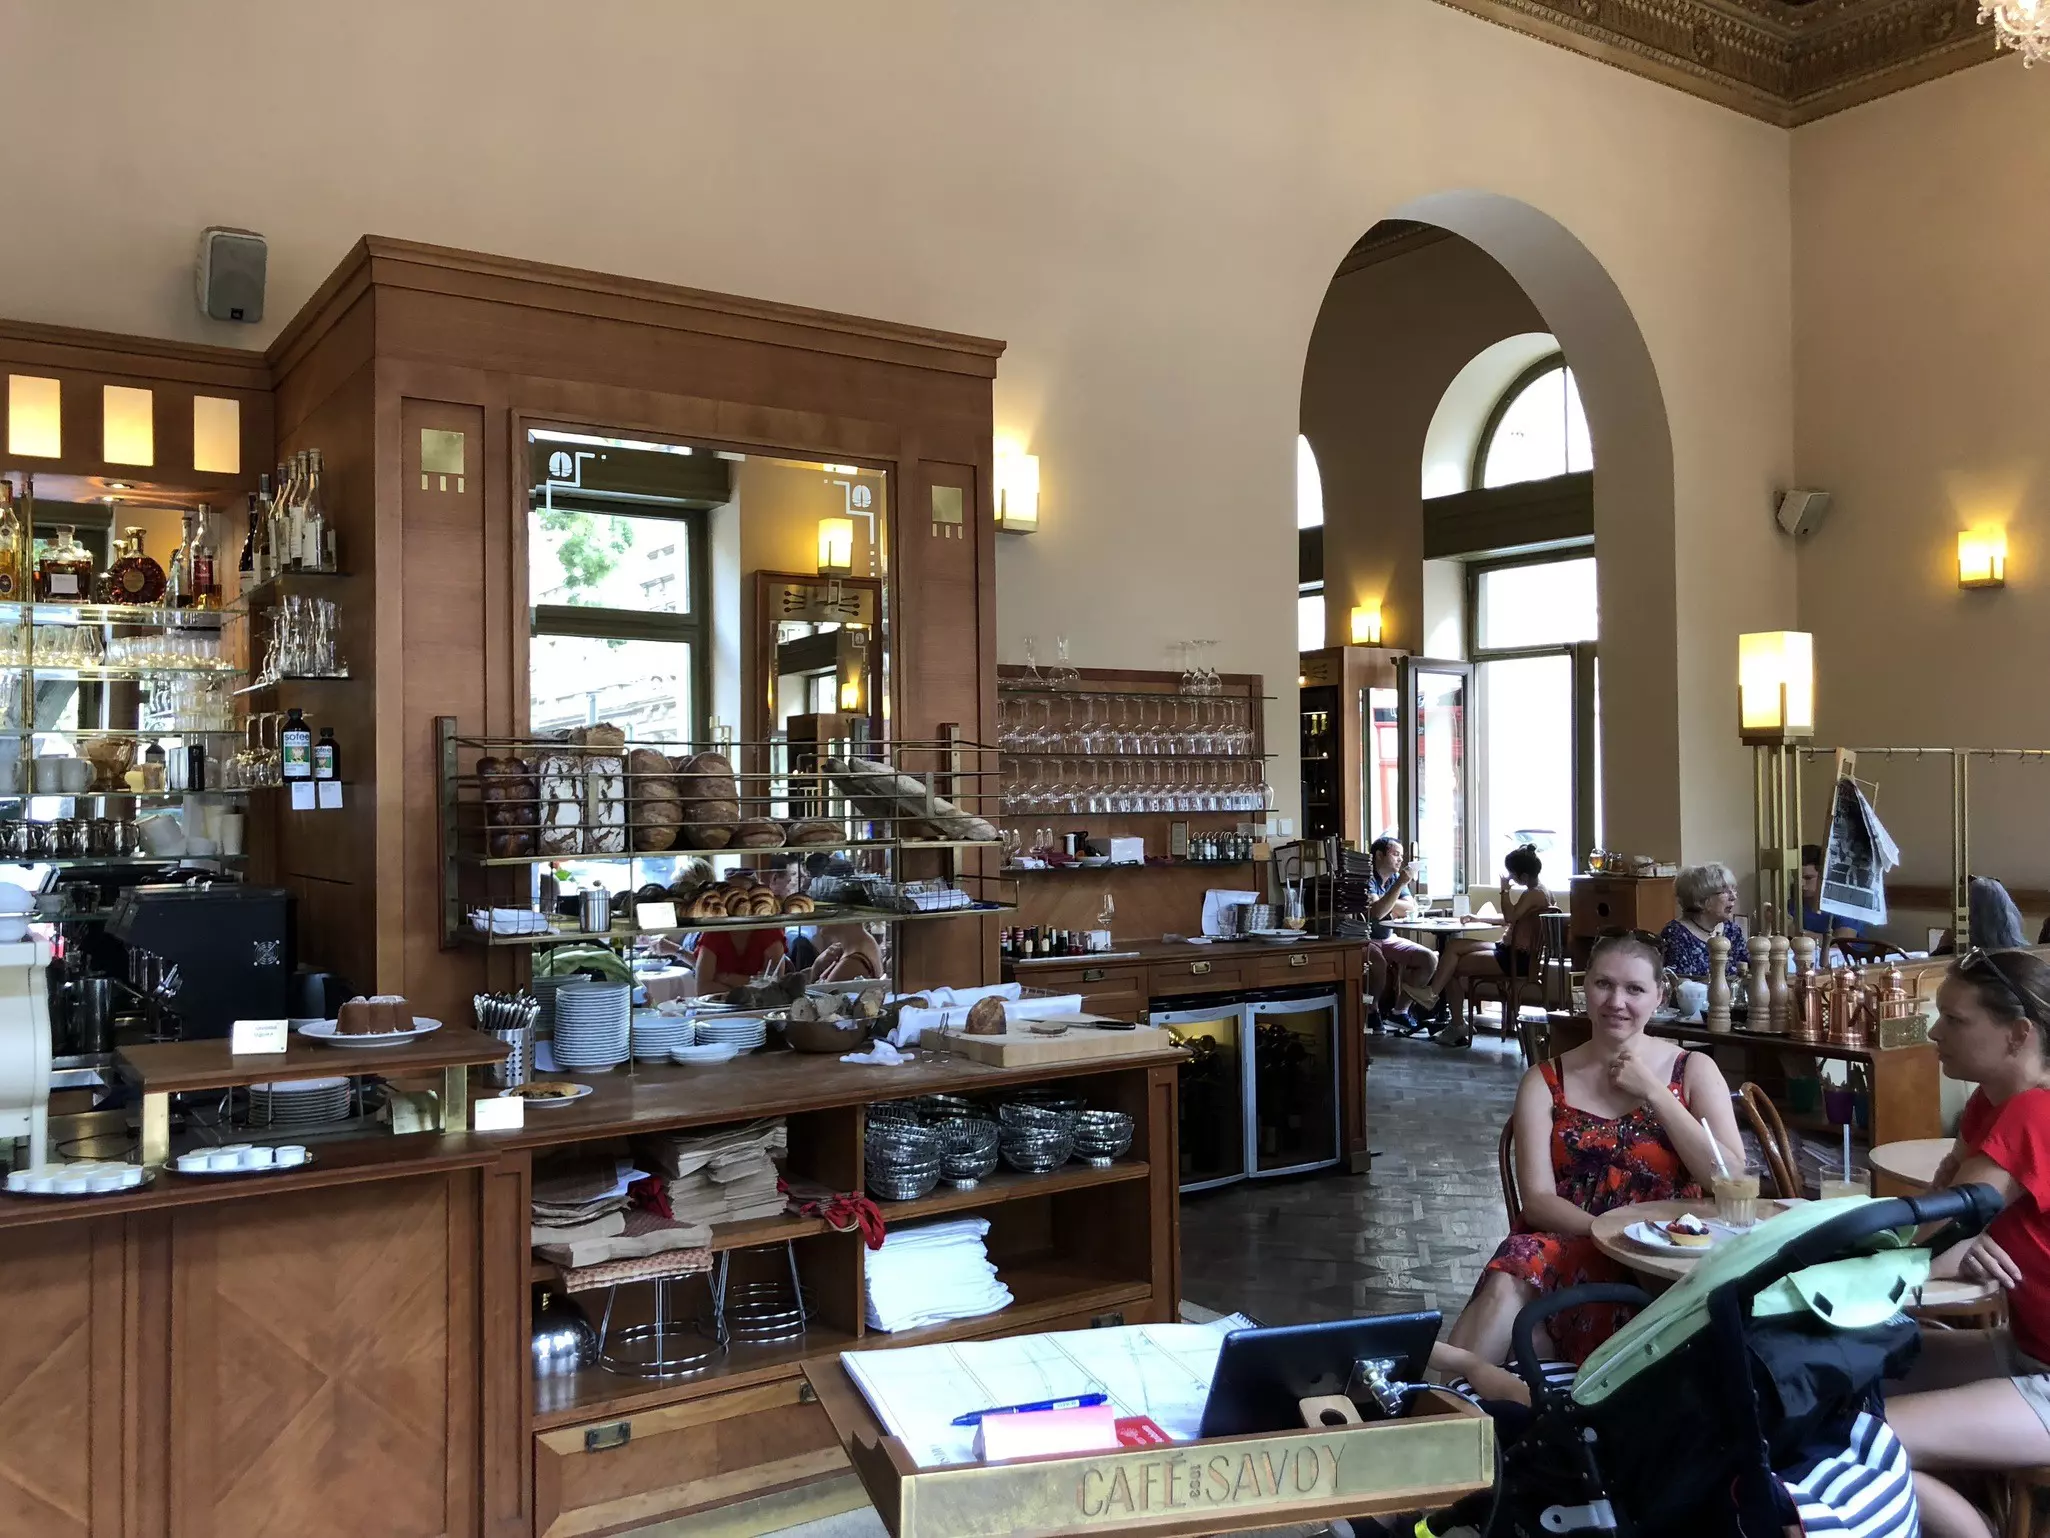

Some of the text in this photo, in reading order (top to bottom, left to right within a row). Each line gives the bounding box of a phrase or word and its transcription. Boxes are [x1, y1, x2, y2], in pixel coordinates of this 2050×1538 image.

[284, 732, 310, 741] sofee
[1078, 1452, 1187, 1517] CAFÉ
[1206, 1444, 1346, 1501] SAVOY
